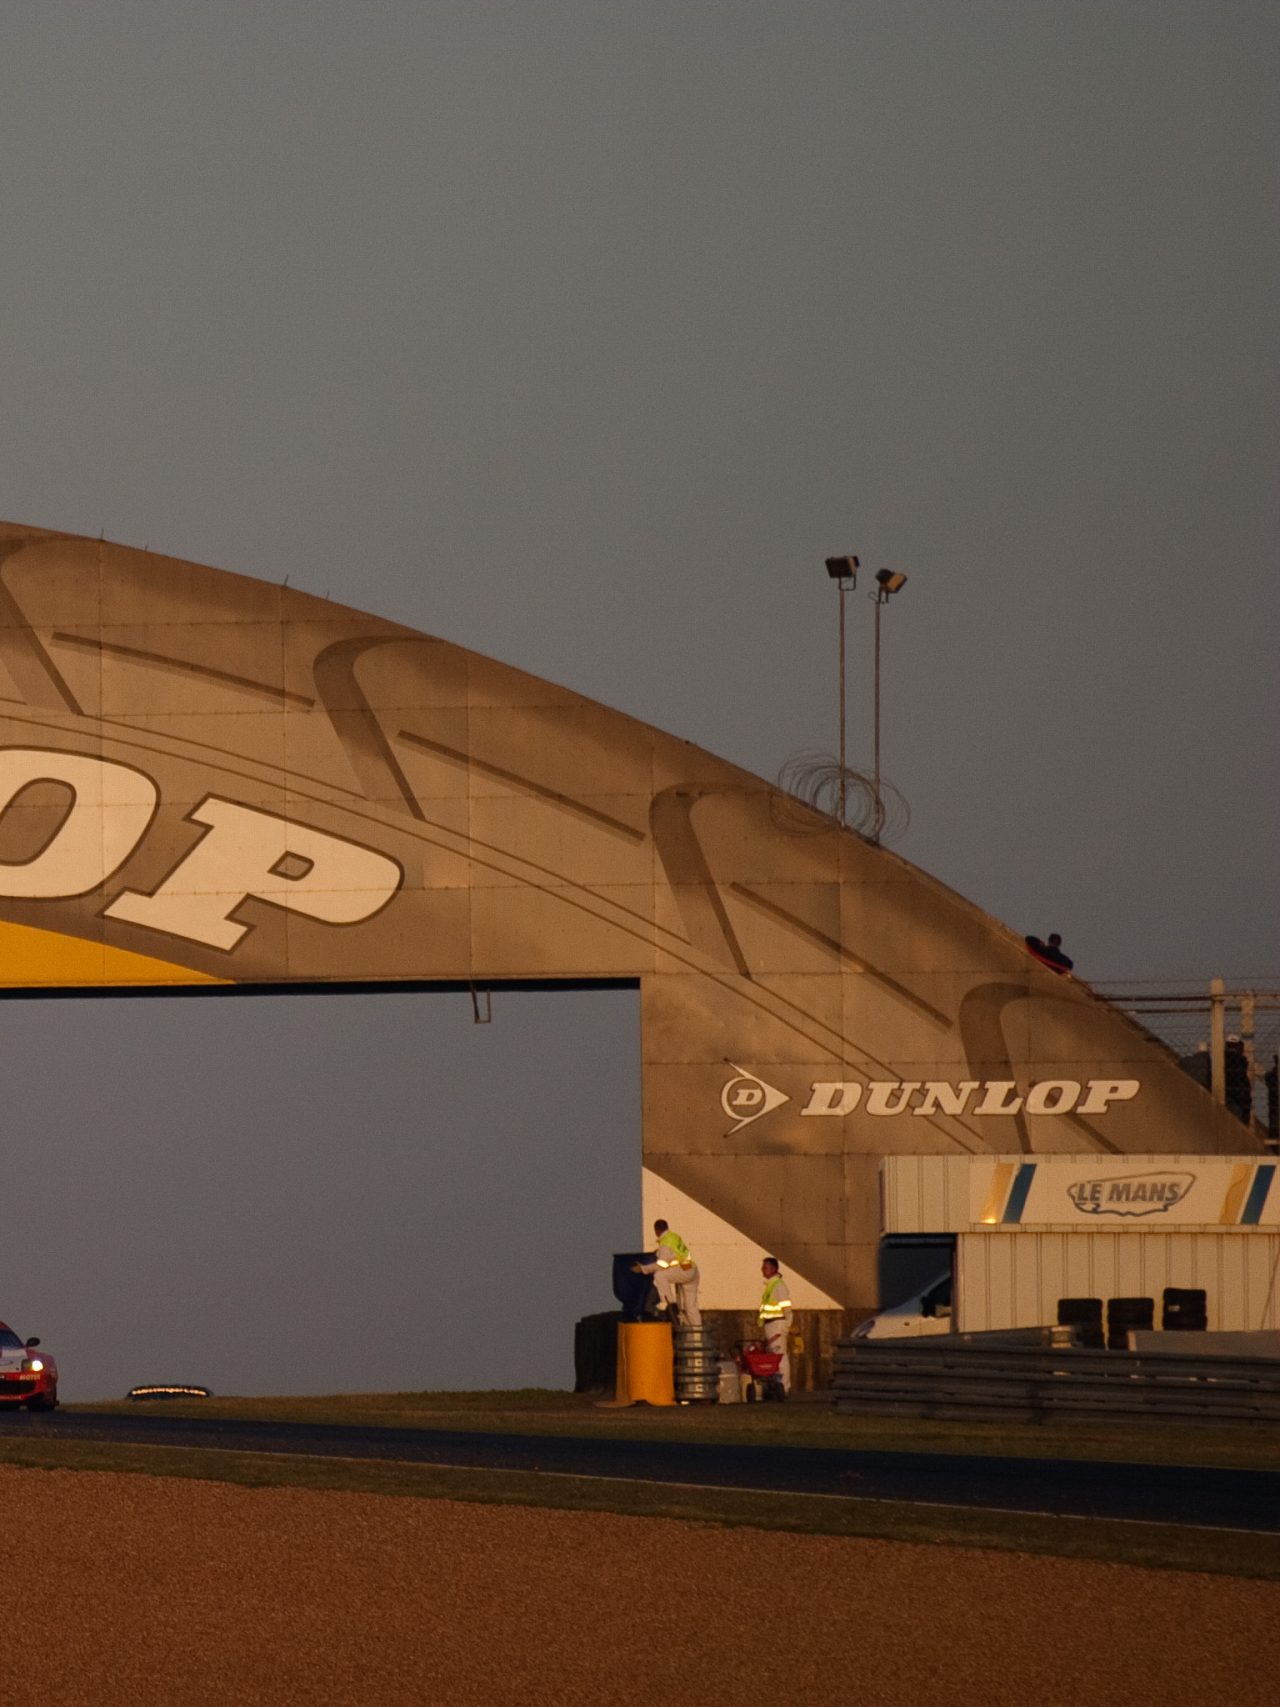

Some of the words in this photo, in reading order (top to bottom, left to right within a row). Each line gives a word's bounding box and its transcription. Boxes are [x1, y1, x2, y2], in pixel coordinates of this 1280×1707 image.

[799, 1079, 1141, 1116] DUNLOP
[1076, 1182, 1103, 1202] LE
[1108, 1182, 1181, 1202] MANS
